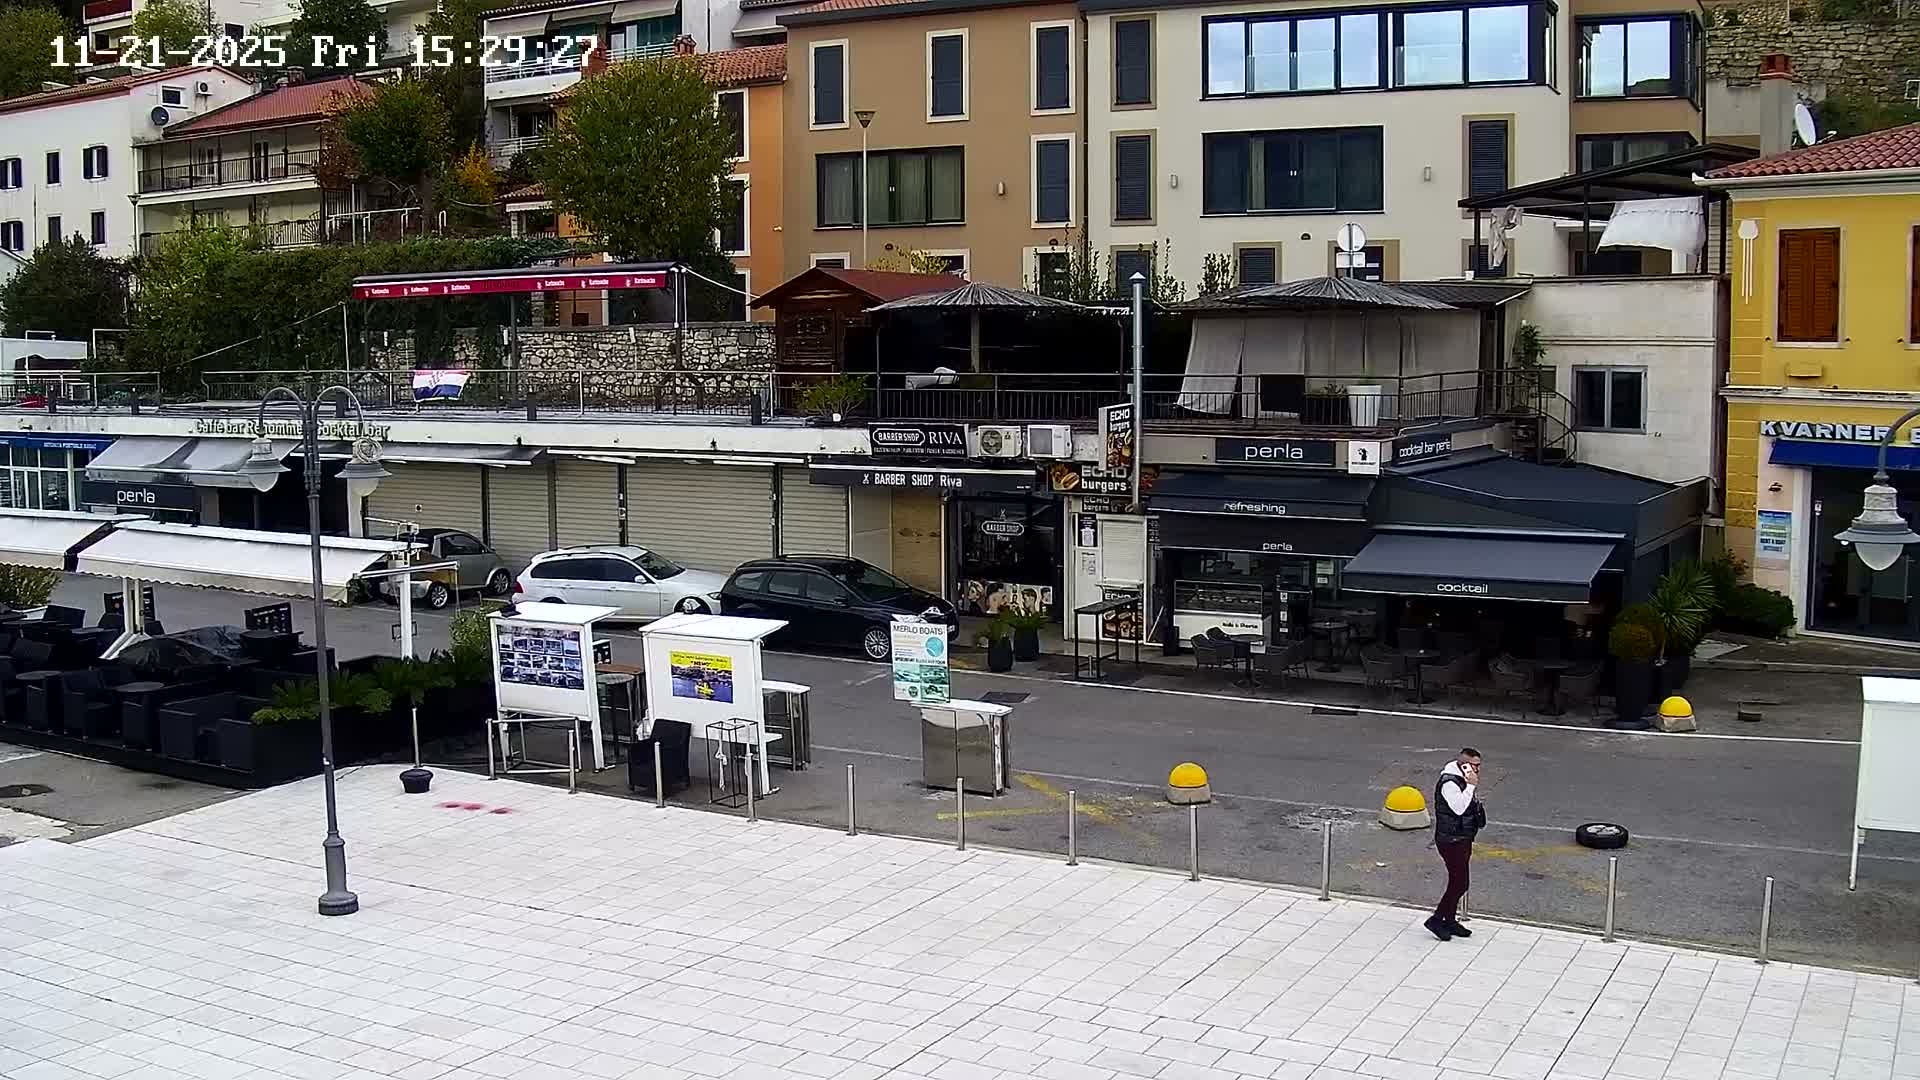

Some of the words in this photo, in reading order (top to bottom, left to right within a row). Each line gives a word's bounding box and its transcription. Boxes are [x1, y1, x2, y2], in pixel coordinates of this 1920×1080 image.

[1110, 408, 1130, 421] ECHO
[227, 420, 245, 434] bar
[365, 422, 391, 437] bar
[1109, 421, 1130, 432] burgers
[1760, 421, 1889, 441] KVARNER
[928, 432, 963, 444] RIVA
[1245, 443, 1304, 460] perla
[1399, 442, 1424, 457] cocktail
[1425, 442, 1435, 453] bar
[1081, 465, 1127, 478] ECHO
[874, 473, 906, 485] BARBER
[911, 474, 934, 486] SHOP
[940, 475, 963, 487] Riva
[1081, 478, 1127, 492] burgers
[117, 488, 155, 504] perla
[1083, 496, 1110, 504] ECHO
[1223, 501, 1286, 514] refreshing
[1262, 542, 1293, 551] perla
[1437, 583, 1488, 593] cocktail
[893, 625, 918, 634] MERLO
[919, 627, 944, 635] BOATS
